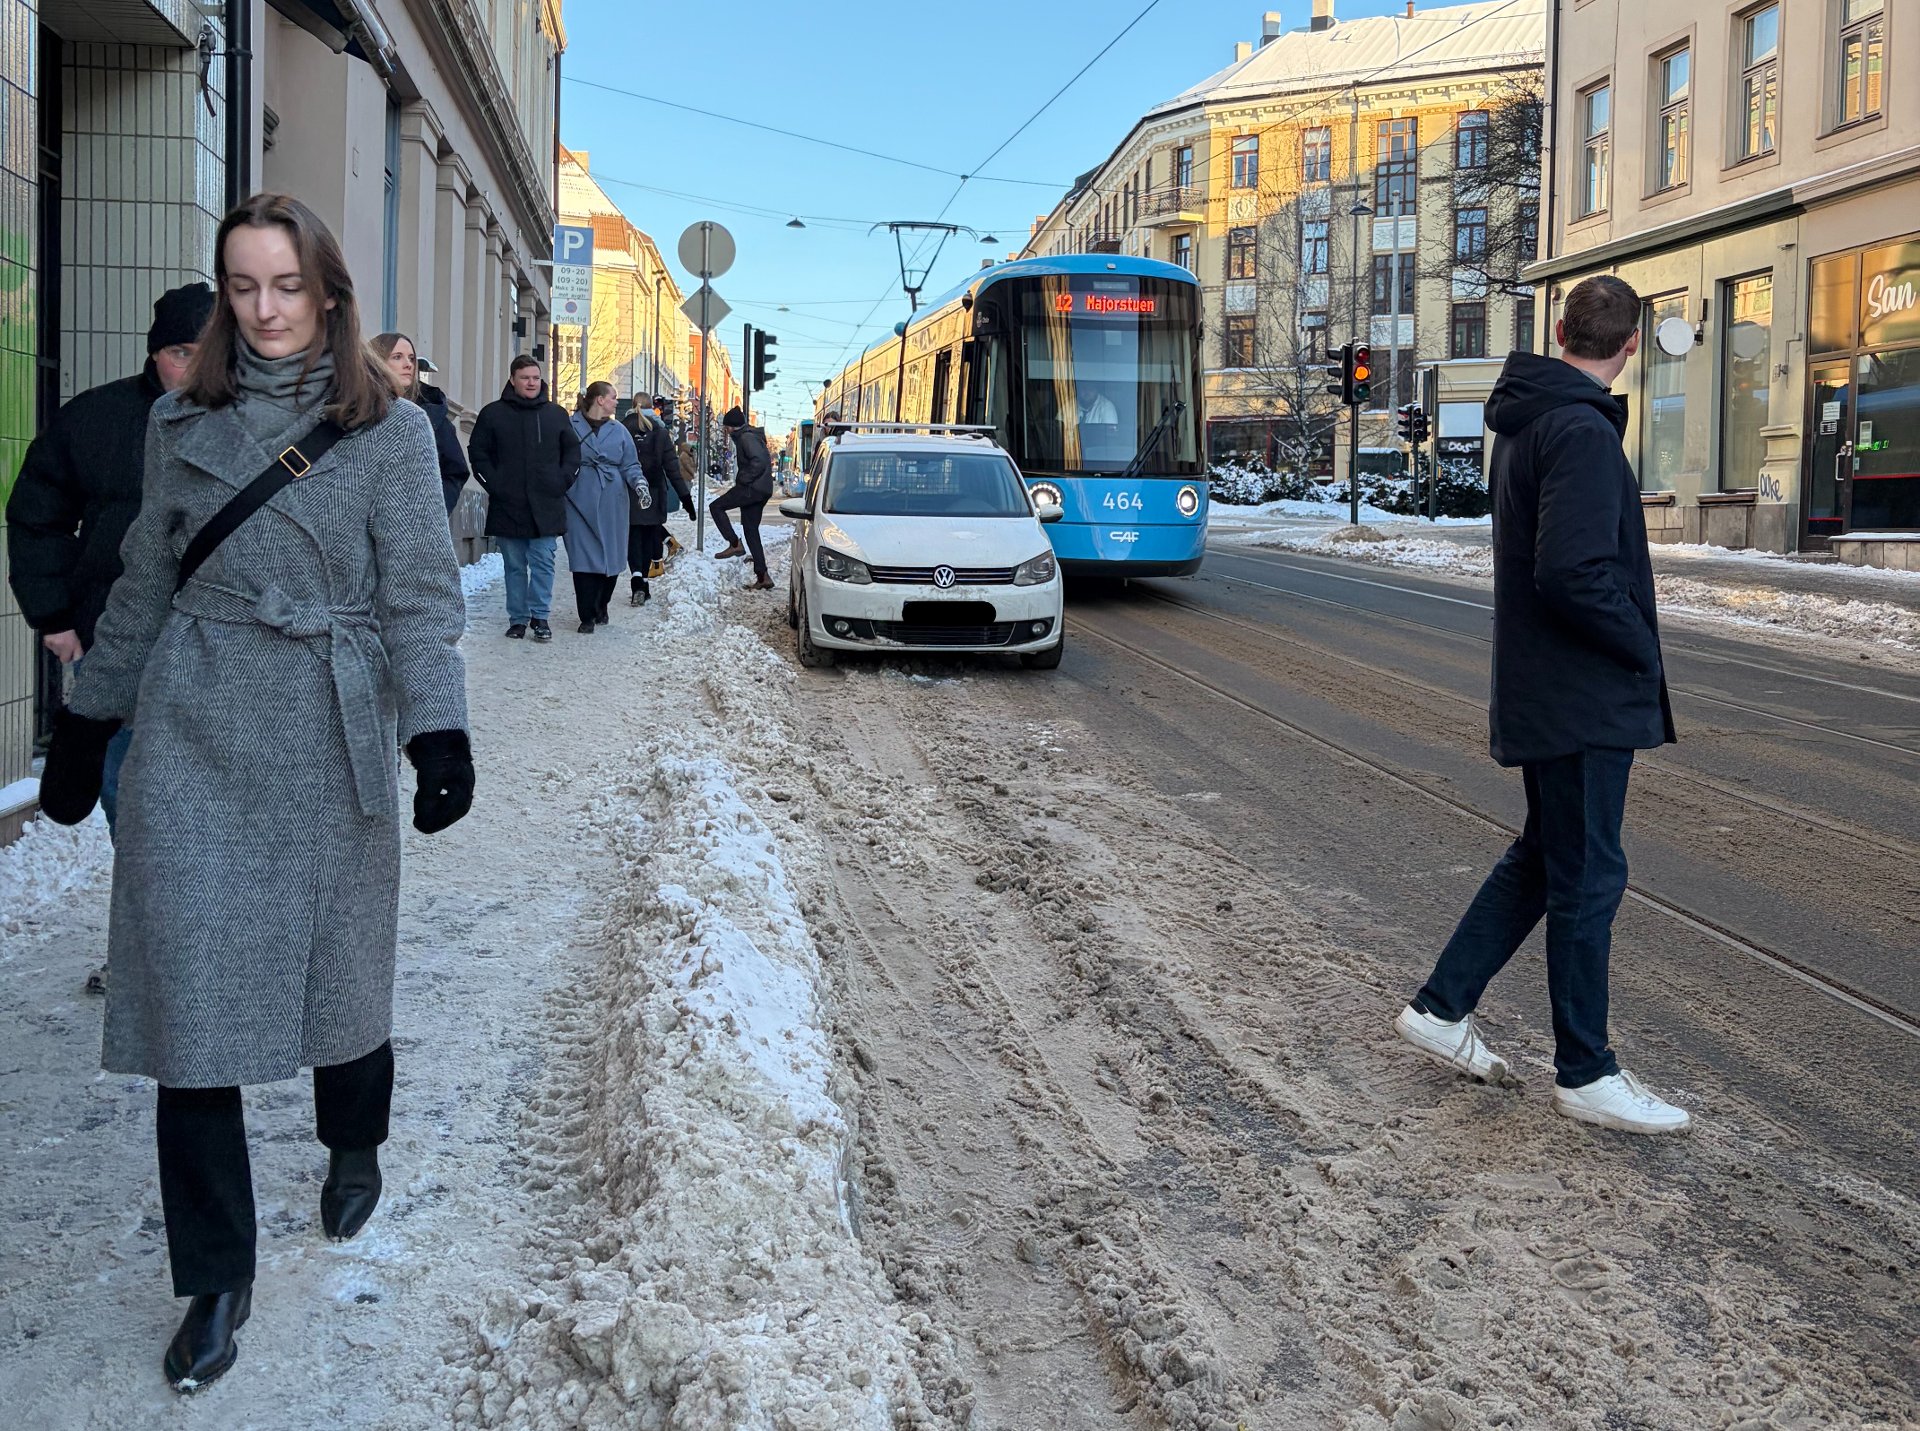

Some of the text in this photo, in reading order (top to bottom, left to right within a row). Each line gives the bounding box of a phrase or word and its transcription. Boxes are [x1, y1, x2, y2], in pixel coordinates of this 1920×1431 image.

[563, 230, 585, 260] P
[1055, 294, 1155, 314] 12 Majorstuen
[1867, 274, 1917, 318] San
[555, 314, 587, 323] Øvrig tid
[1103, 492, 1144, 510] 464
[1110, 531, 1140, 543] CAF
